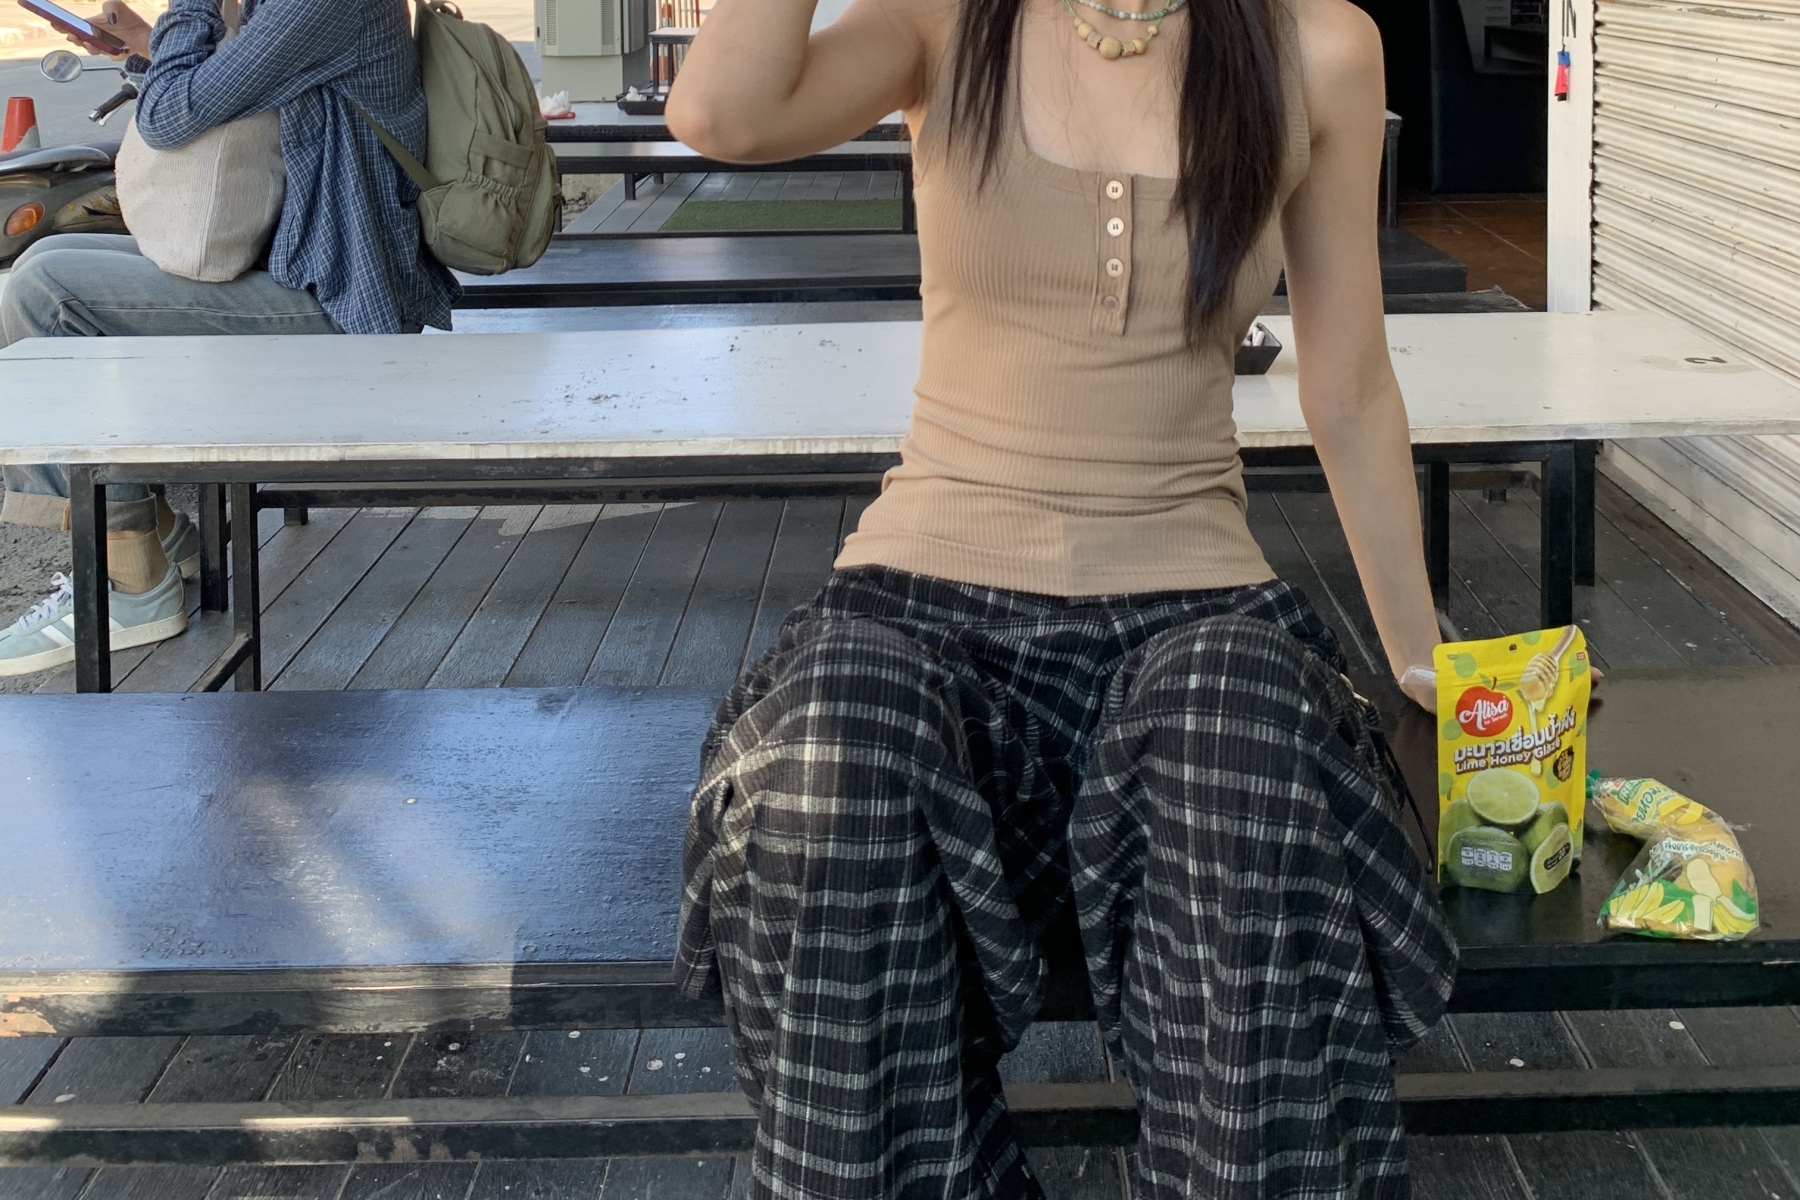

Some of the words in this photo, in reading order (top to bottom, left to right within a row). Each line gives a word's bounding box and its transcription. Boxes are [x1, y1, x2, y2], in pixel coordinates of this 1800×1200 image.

[1459, 698, 1509, 731] Alisa
[1457, 757, 1487, 772] Lime
[1491, 751, 1532, 767] Honey
[1535, 740, 1560, 759] Glaze
[1620, 779, 1641, 800] FRES
